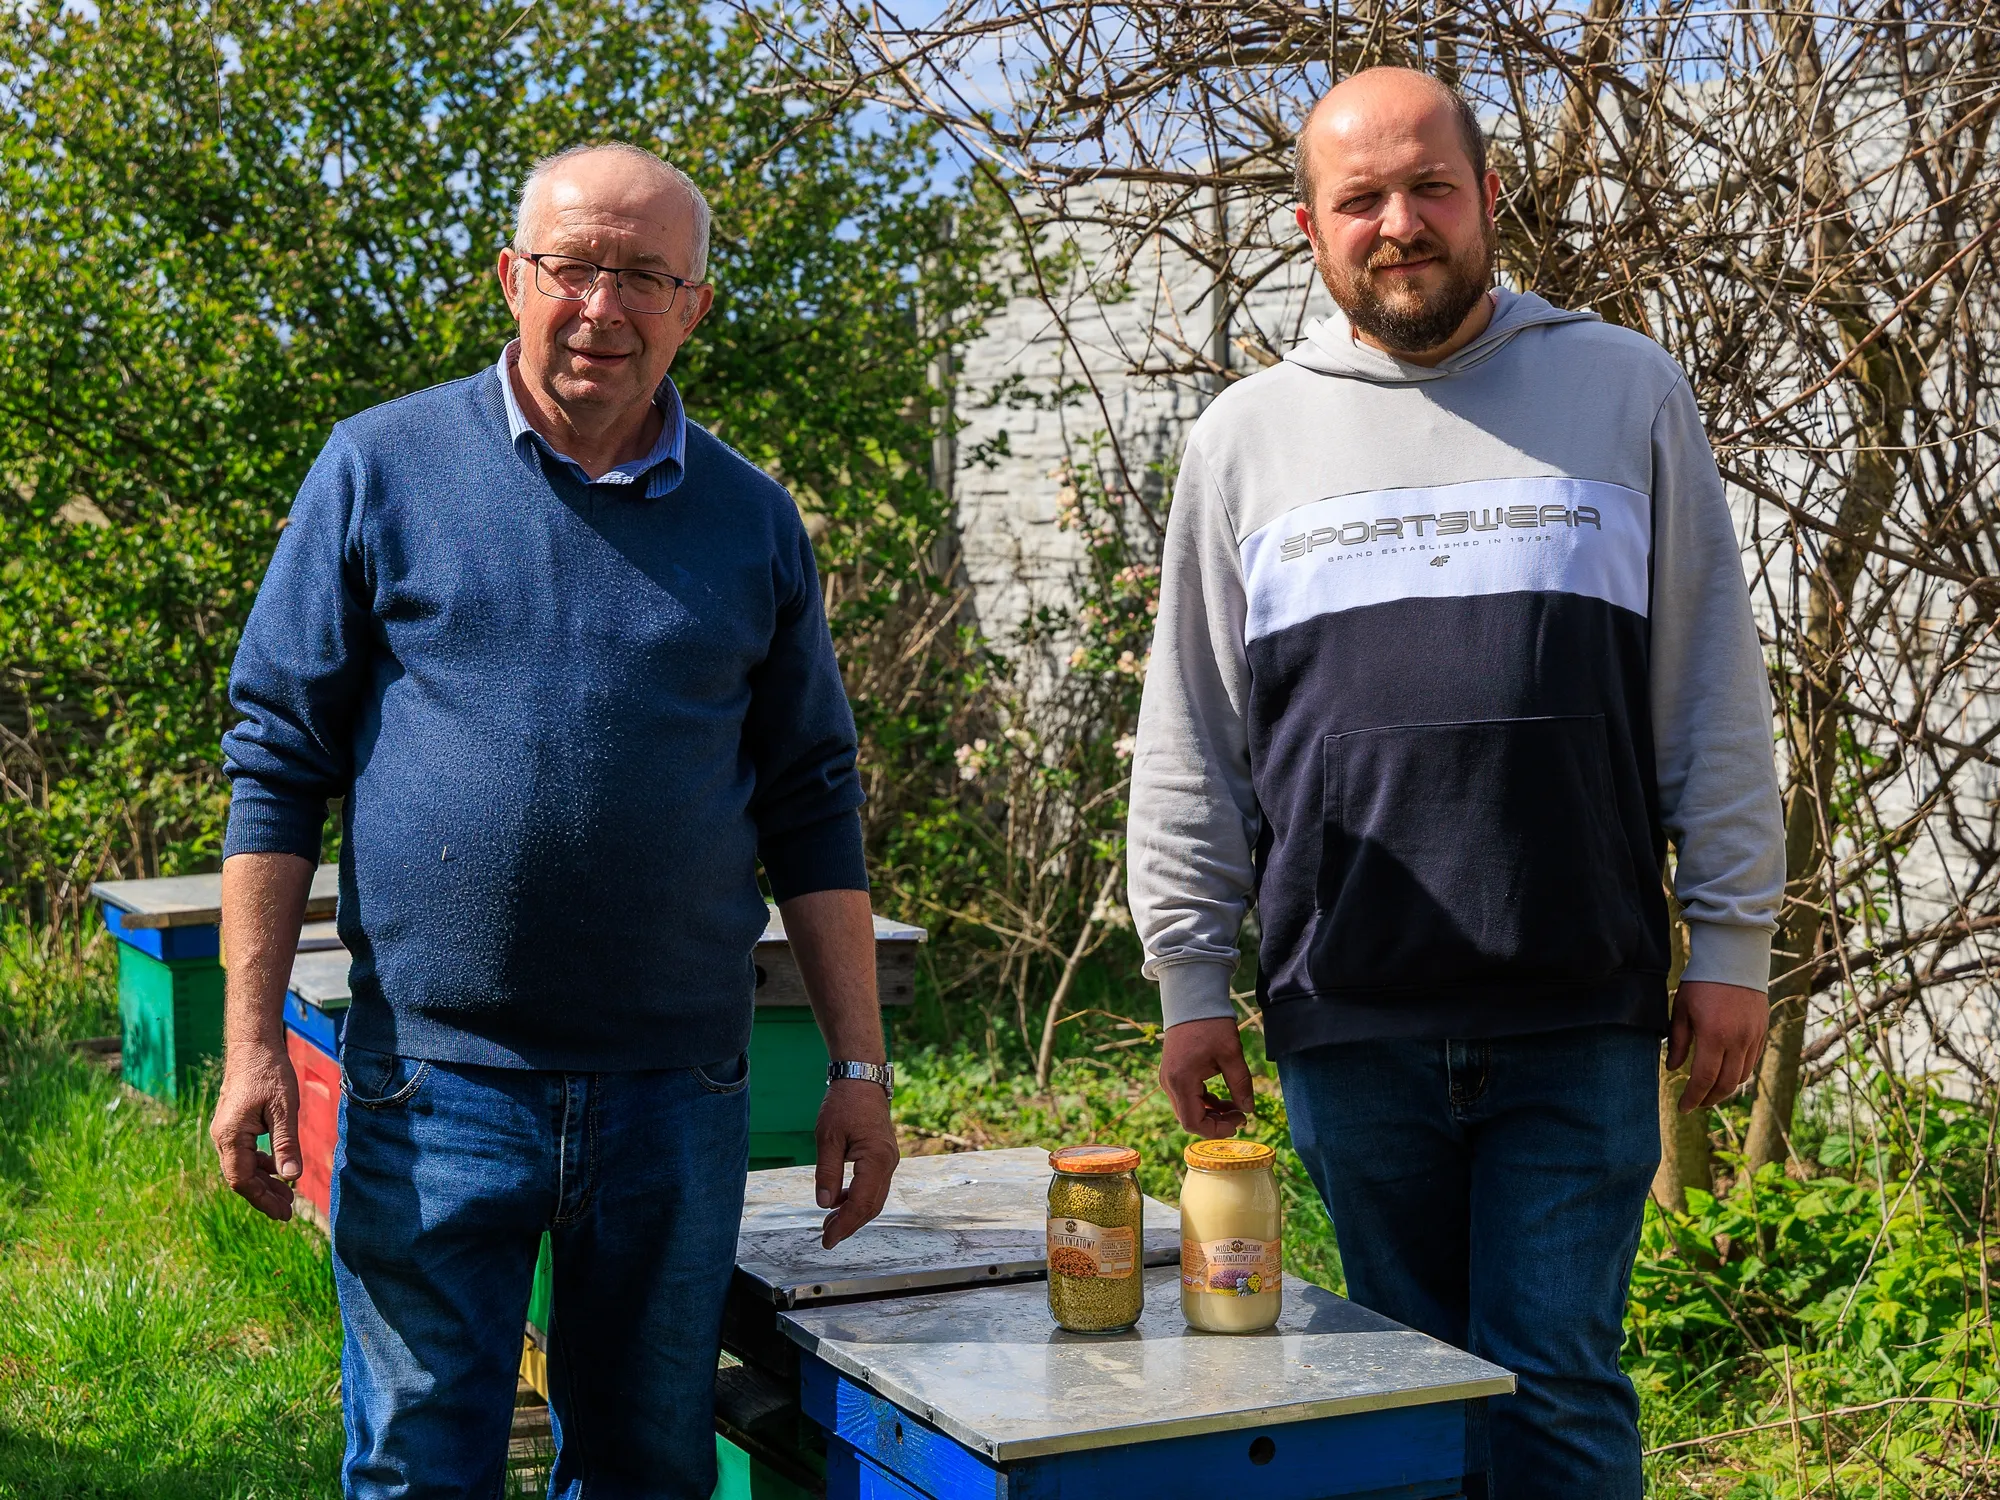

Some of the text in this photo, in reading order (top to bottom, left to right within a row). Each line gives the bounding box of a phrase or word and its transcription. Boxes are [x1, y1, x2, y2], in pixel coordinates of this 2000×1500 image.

[1280, 504, 1601, 562] SPORTSWEAR
[1328, 534, 1552, 562] BRAND ESTABLISHED IN 19/95
[1429, 555, 1450, 567] 4F
